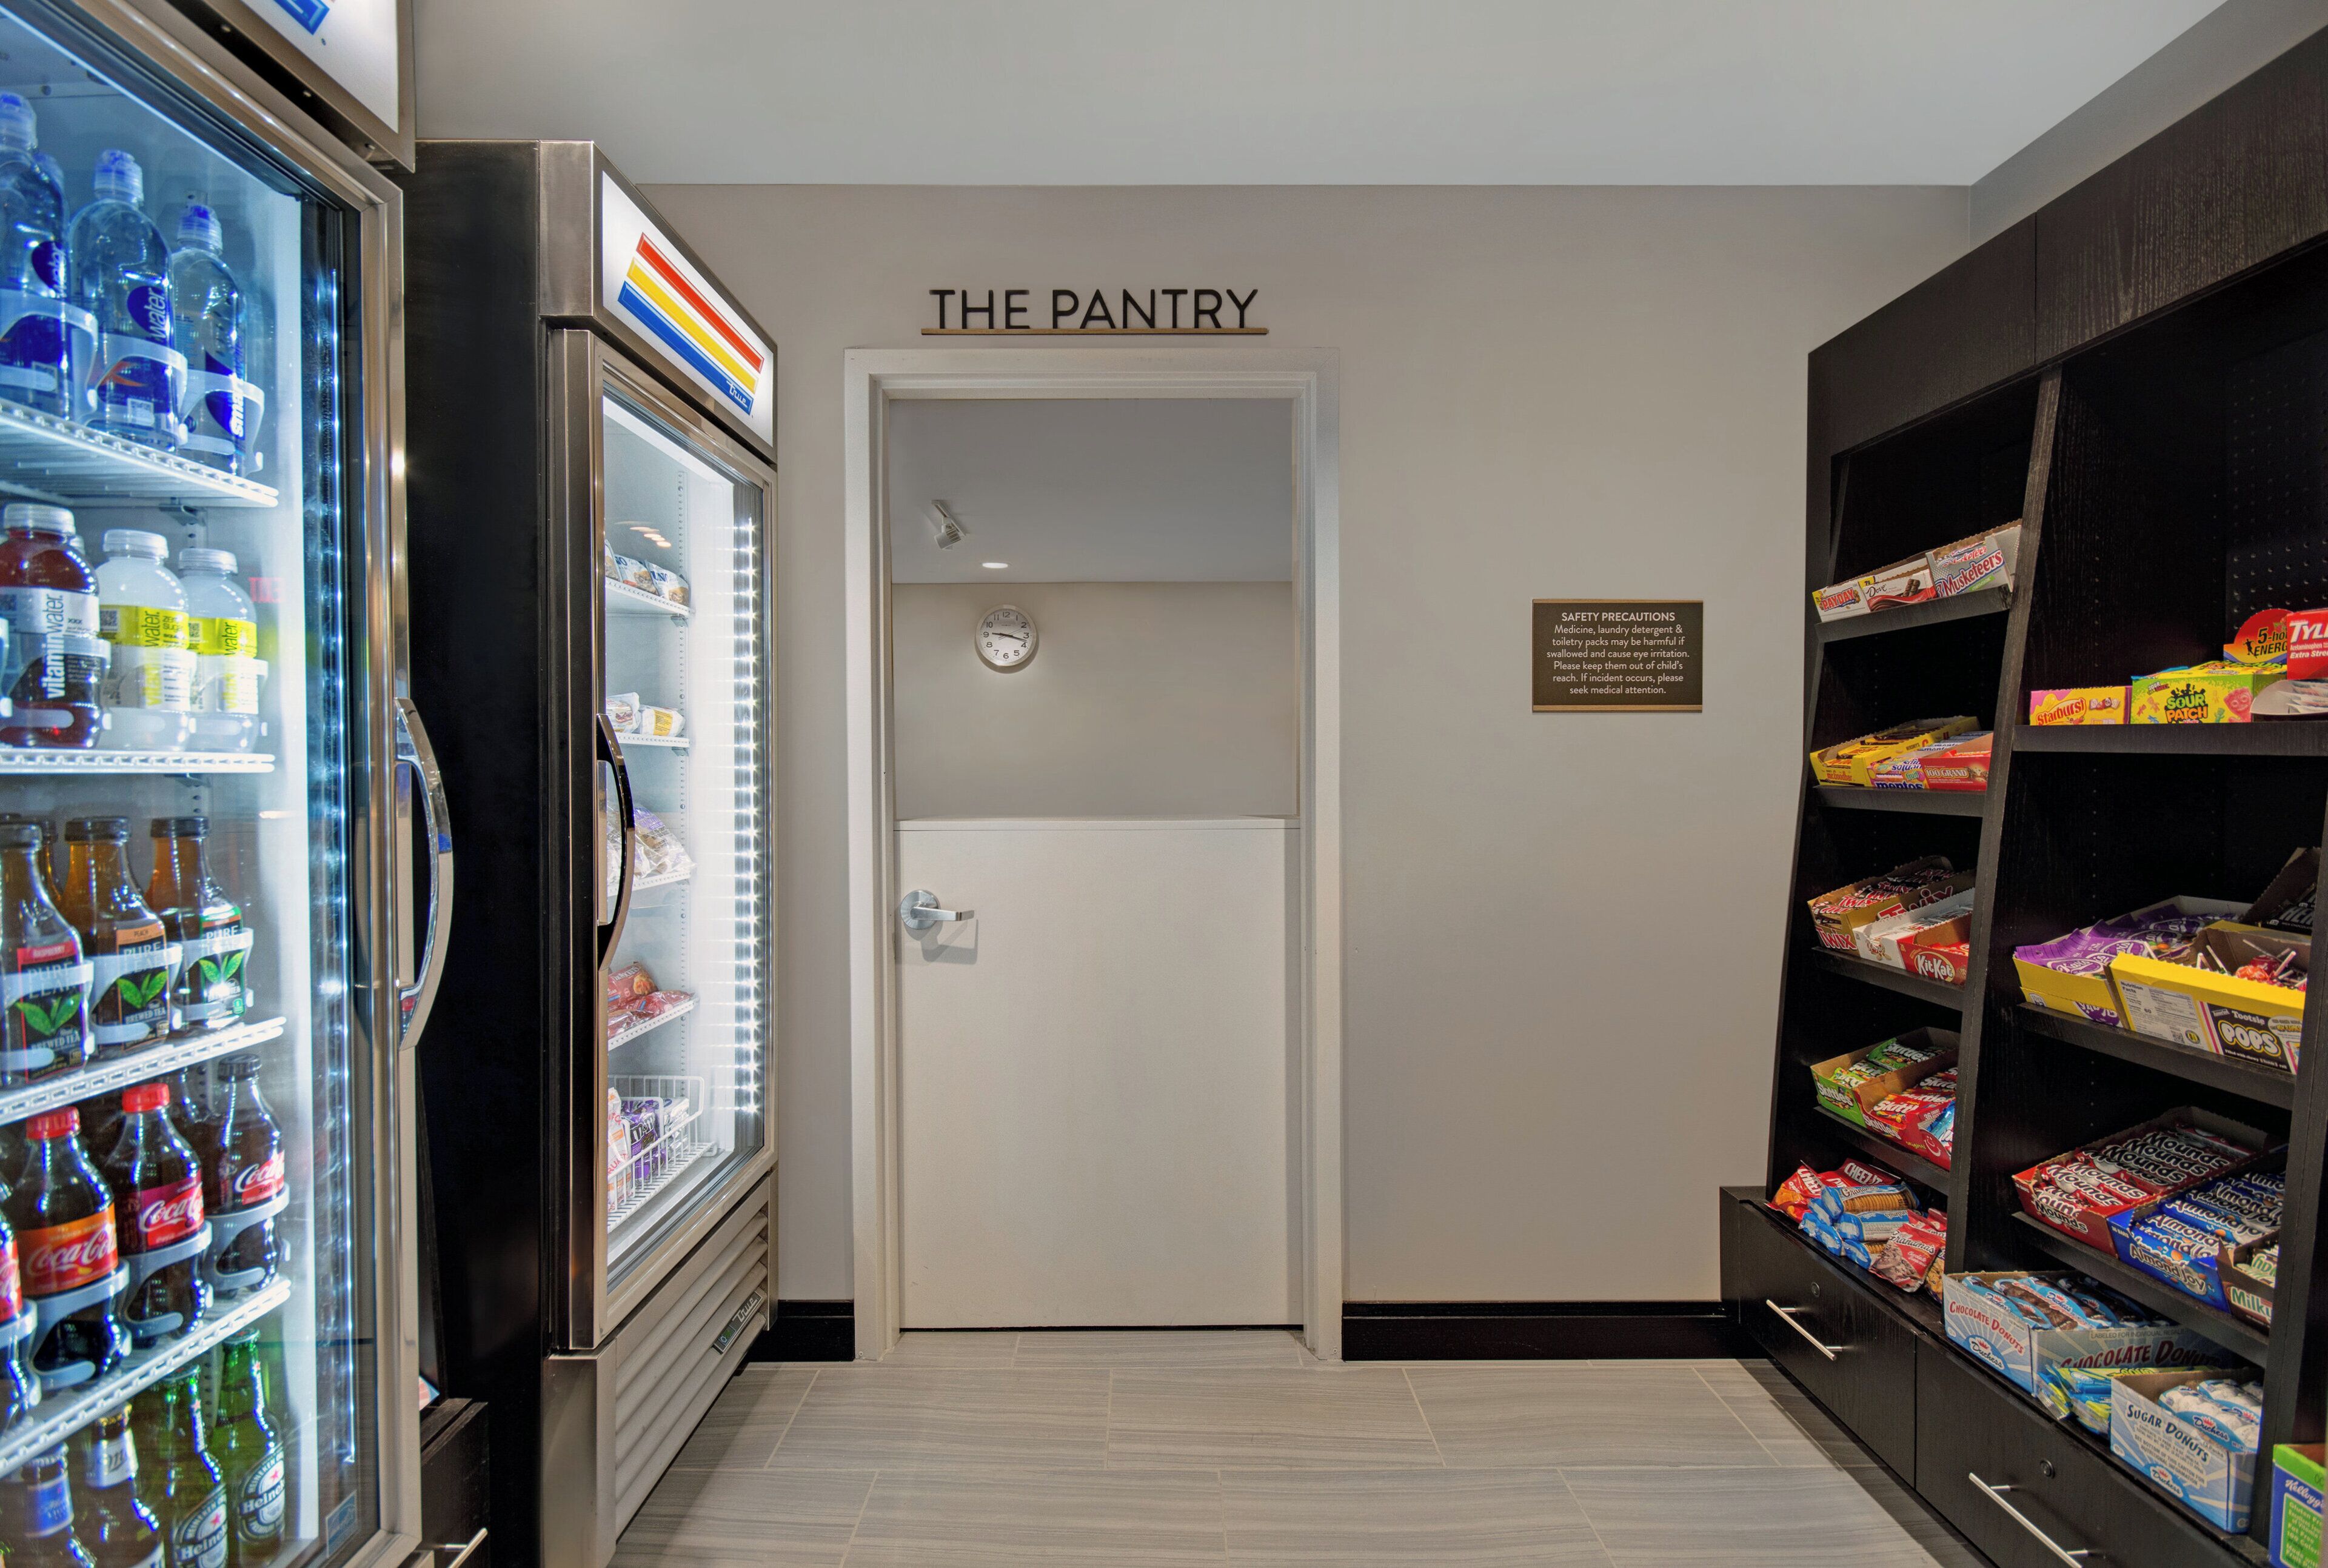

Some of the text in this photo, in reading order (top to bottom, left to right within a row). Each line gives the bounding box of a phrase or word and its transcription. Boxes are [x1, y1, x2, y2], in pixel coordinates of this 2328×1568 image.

[146, 287, 166, 339] water
[929, 289, 1258, 329] THE PANTRY
[1942, 551, 2002, 597] Musketeers
[1821, 589, 1854, 610] PAYDAY
[1865, 584, 1887, 598] Dove
[1562, 612, 1676, 621] SAFETY PRECAUTIONS
[1554, 624, 1682, 636] Medicine, laundry detergent &
[1547, 649, 1588, 658] swallowed
[1590, 649, 1605, 658] and
[1633, 651, 1648, 660] eye
[1650, 649, 1690, 658] irritation.
[1553, 636, 1685, 649] toiletry packs may be harmful if
[2253, 641, 2287, 657] ENERG
[2290, 642, 2322, 652] Acetaminophen
[1553, 673, 1684, 685] reach. If incident occurs, please
[1554, 661, 1580, 670] Please
[1582, 661, 1602, 673] keep
[1605, 661, 1627, 670] them
[1629, 662, 1644, 670] out
[1645, 661, 1656, 670] of
[1570, 686, 1667, 695] seek medical attention.
[2149, 682, 2161, 691] SOUR
[2037, 699, 2085, 726] Starburst
[2166, 693, 2205, 709] SOUR
[2166, 705, 2207, 722] PATCH
[1926, 767, 1969, 779] 100 GRAND
[124, 941, 161, 959] PURE
[1816, 926, 1858, 950] Twix
[28, 961, 73, 981] PURE
[2121, 981, 2144, 991] Nutrition
[2122, 986, 2136, 994] Facts
[2231, 1010, 2266, 1026] Tootsie
[65, 1032, 81, 1046] TEA
[2220, 1022, 2278, 1055] POPS
[1816, 1083, 1854, 1107] Skittles
[1862, 1113, 1902, 1140] Skittles
[2123, 1139, 2209, 1176] Mounds
[2144, 1132, 2230, 1169] Mounds
[2102, 1145, 2187, 1183] Mounds
[2046, 1164, 2123, 1207] Mounds
[2067, 1162, 2147, 1199] Mounds
[2033, 1200, 2089, 1235] Mounds
[2130, 1243, 2206, 1292] Almond Joy
[1949, 1301, 2024, 1355] CHOCOLATE DONUTS
[1971, 1340, 2003, 1369] Duchess
[2127, 1404, 2209, 1462] SUGAR DONUTS
[2192, 1415, 2229, 1441] Duchess
[2141, 1444, 2167, 1465] NUTRITIONAL
[2168, 1462, 2197, 1485] INFORMATION
[2142, 1439, 2159, 1453] BOTTOM
[2167, 1455, 2176, 1464] THIS
[2178, 1462, 2194, 1476] CARTON
[2196, 1473, 2204, 1483] FOR
[2152, 1469, 2181, 1494] Duchess
